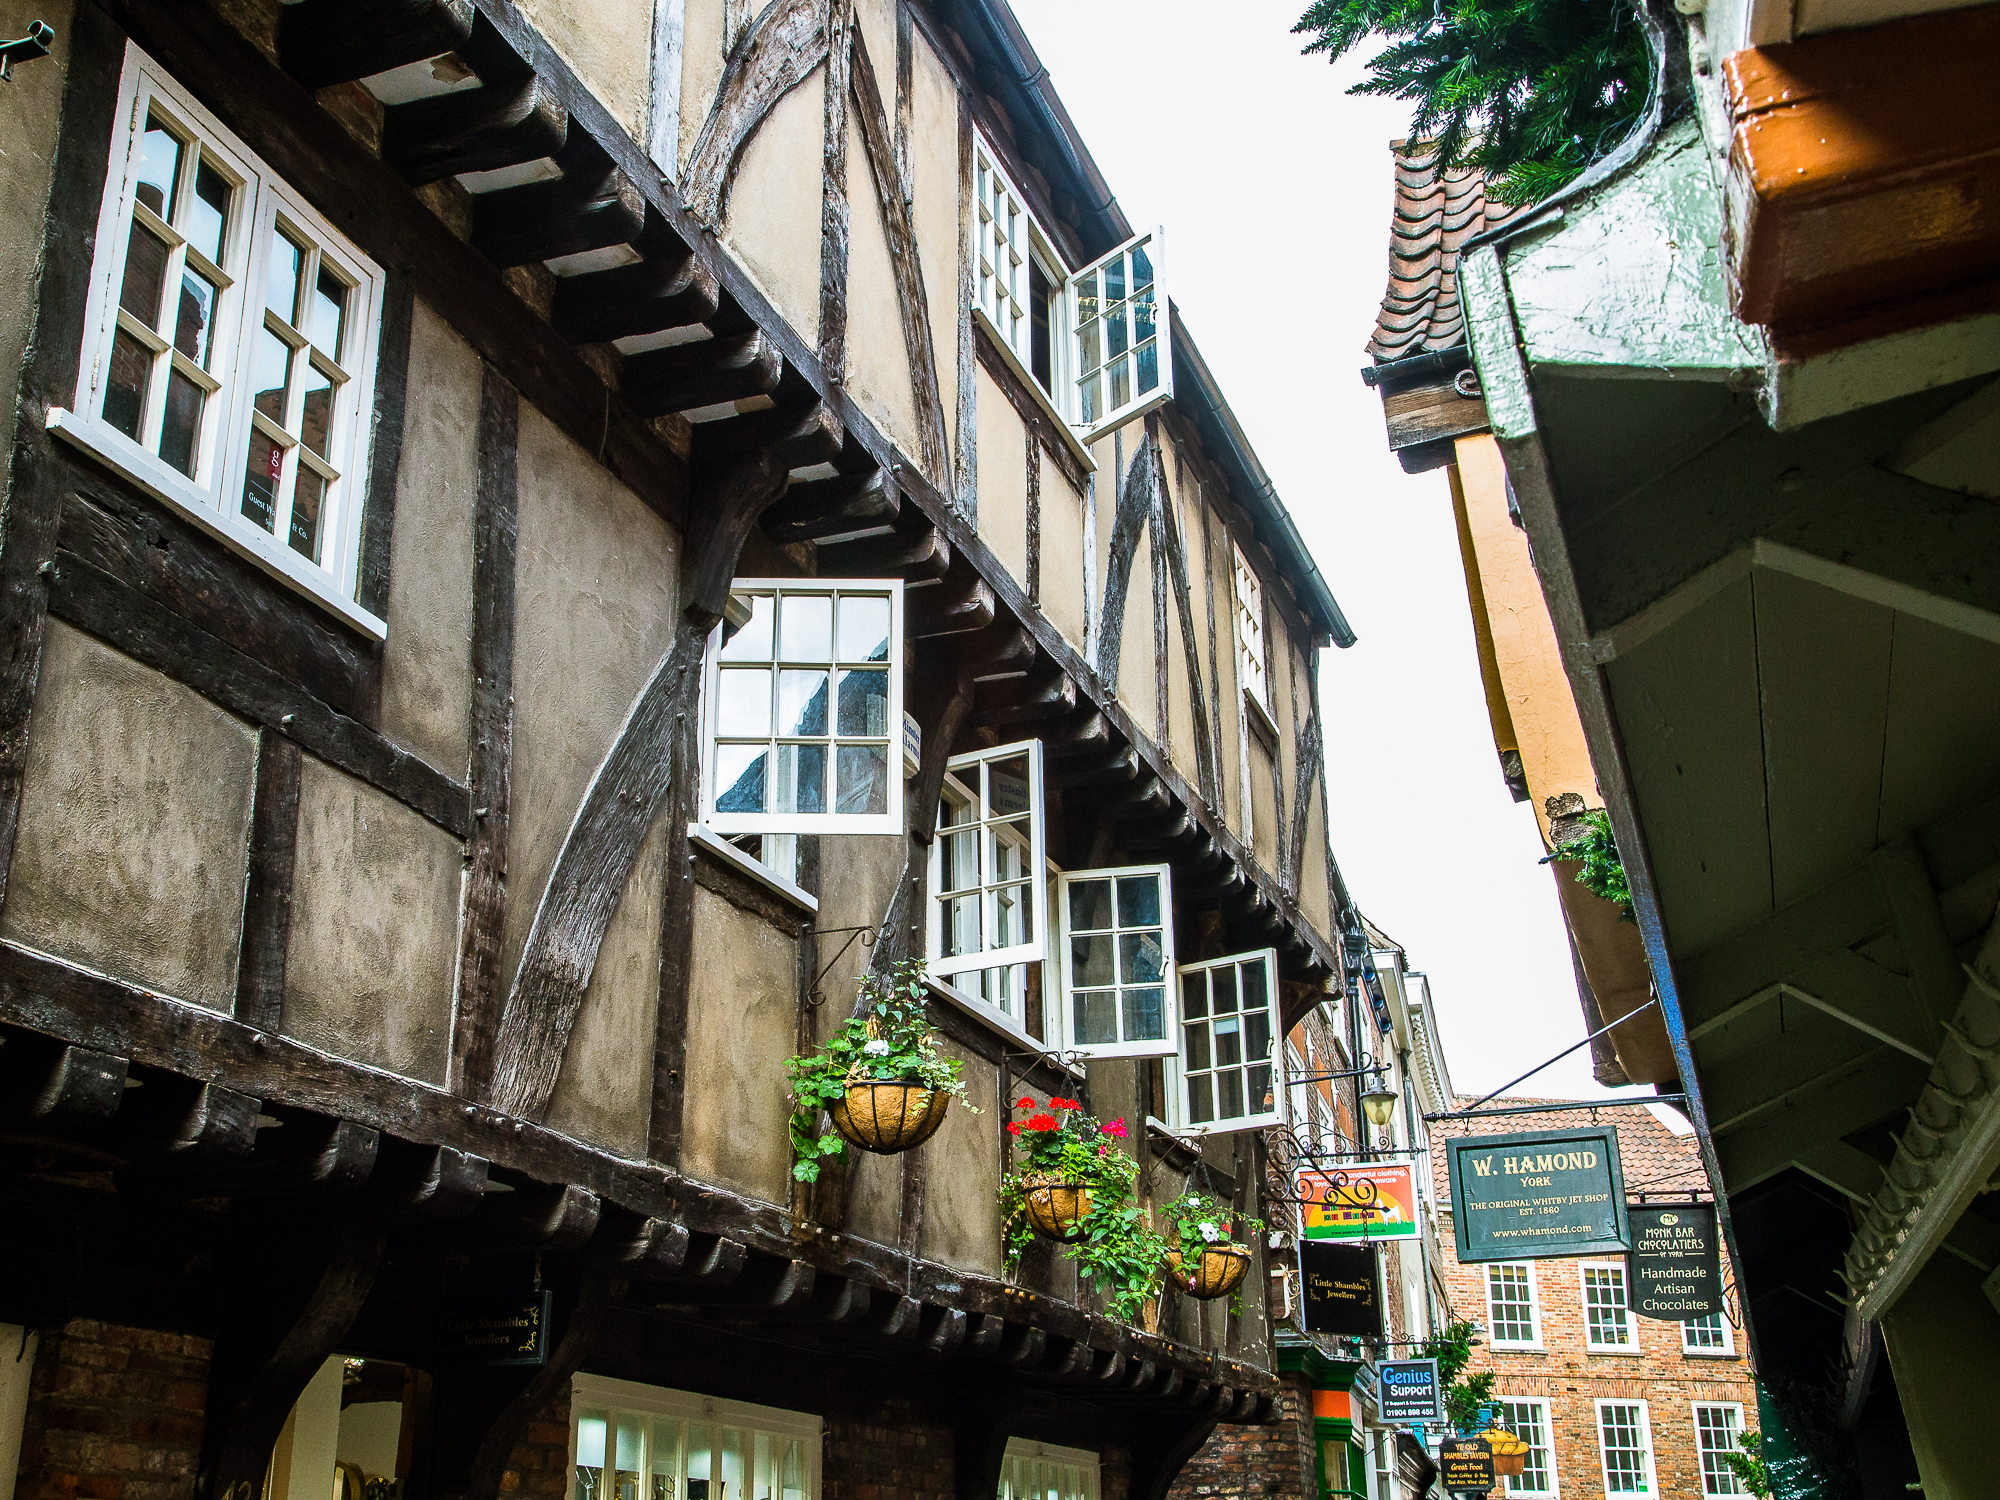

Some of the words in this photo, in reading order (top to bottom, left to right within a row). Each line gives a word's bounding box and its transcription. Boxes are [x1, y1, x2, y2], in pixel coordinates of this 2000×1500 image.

[248, 492, 266, 510] Guest
[298, 527, 308, 540] Co.
[1472, 1154, 1498, 1177] W.
[1503, 1151, 1598, 1175] HAMOND
[1520, 1176, 1552, 1188] YORK
[1469, 1202, 1487, 1211] THE
[1488, 1199, 1531, 1209] ORIGINAL
[1532, 1196, 1568, 1206] WHITBY
[1568, 1195, 1583, 1206] JET
[1584, 1193, 1609, 1203] SHOP
[1519, 1208, 1536, 1216] EST.
[1538, 1206, 1560, 1215] 1860
[1492, 1224, 1593, 1238] www.whamond.com
[1645, 1228, 1673, 1239] MONK
[1675, 1227, 1695, 1238] BAR
[1638, 1239, 1705, 1251] CHOCOLATIERS
[1641, 1266, 1707, 1279] Handmade
[1315, 1279, 1333, 1288] Little
[1334, 1281, 1366, 1291] Shambles
[1654, 1283, 1696, 1294] Artisan
[1326, 1290, 1356, 1299] Jewellers
[1642, 1298, 1709, 1311] Chocolates
[478, 1316, 529, 1330] Shambles
[463, 1334, 510, 1348] Jewellers
[1382, 1367, 1432, 1385] Genius
[1390, 1384, 1433, 1397] Support
[1421, 1408, 1435, 1416] 455
[1455, 1443, 1463, 1451] YE
[1464, 1443, 1479, 1451] OLD
[1443, 1452, 1469, 1460] SHAMBLES
[1469, 1452, 1490, 1460] TAVERN
[1450, 1462, 1468, 1471] Great
[1469, 1462, 1484, 1471] Food
